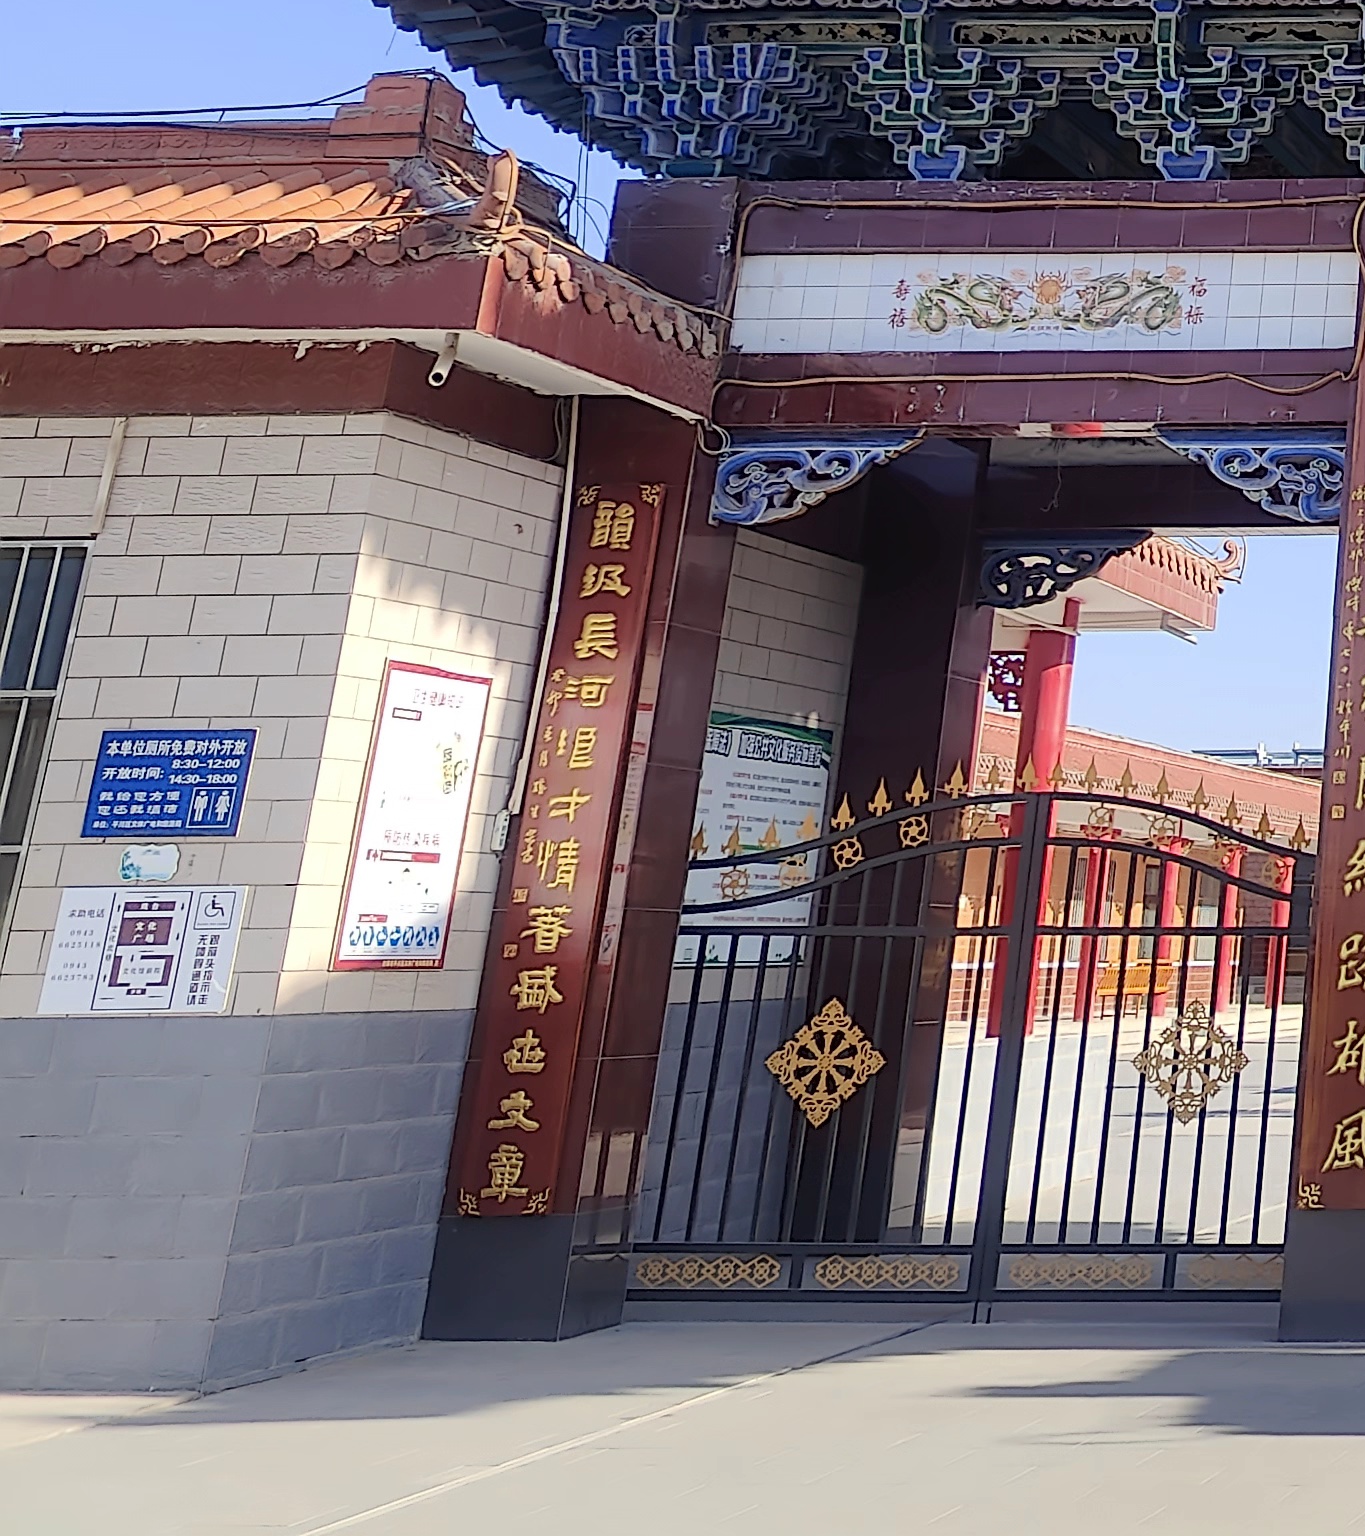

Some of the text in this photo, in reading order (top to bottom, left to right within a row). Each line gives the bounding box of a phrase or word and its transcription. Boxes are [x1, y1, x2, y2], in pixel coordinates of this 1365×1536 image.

[106, 739, 248, 756] 本单位厕所免费对外开放
